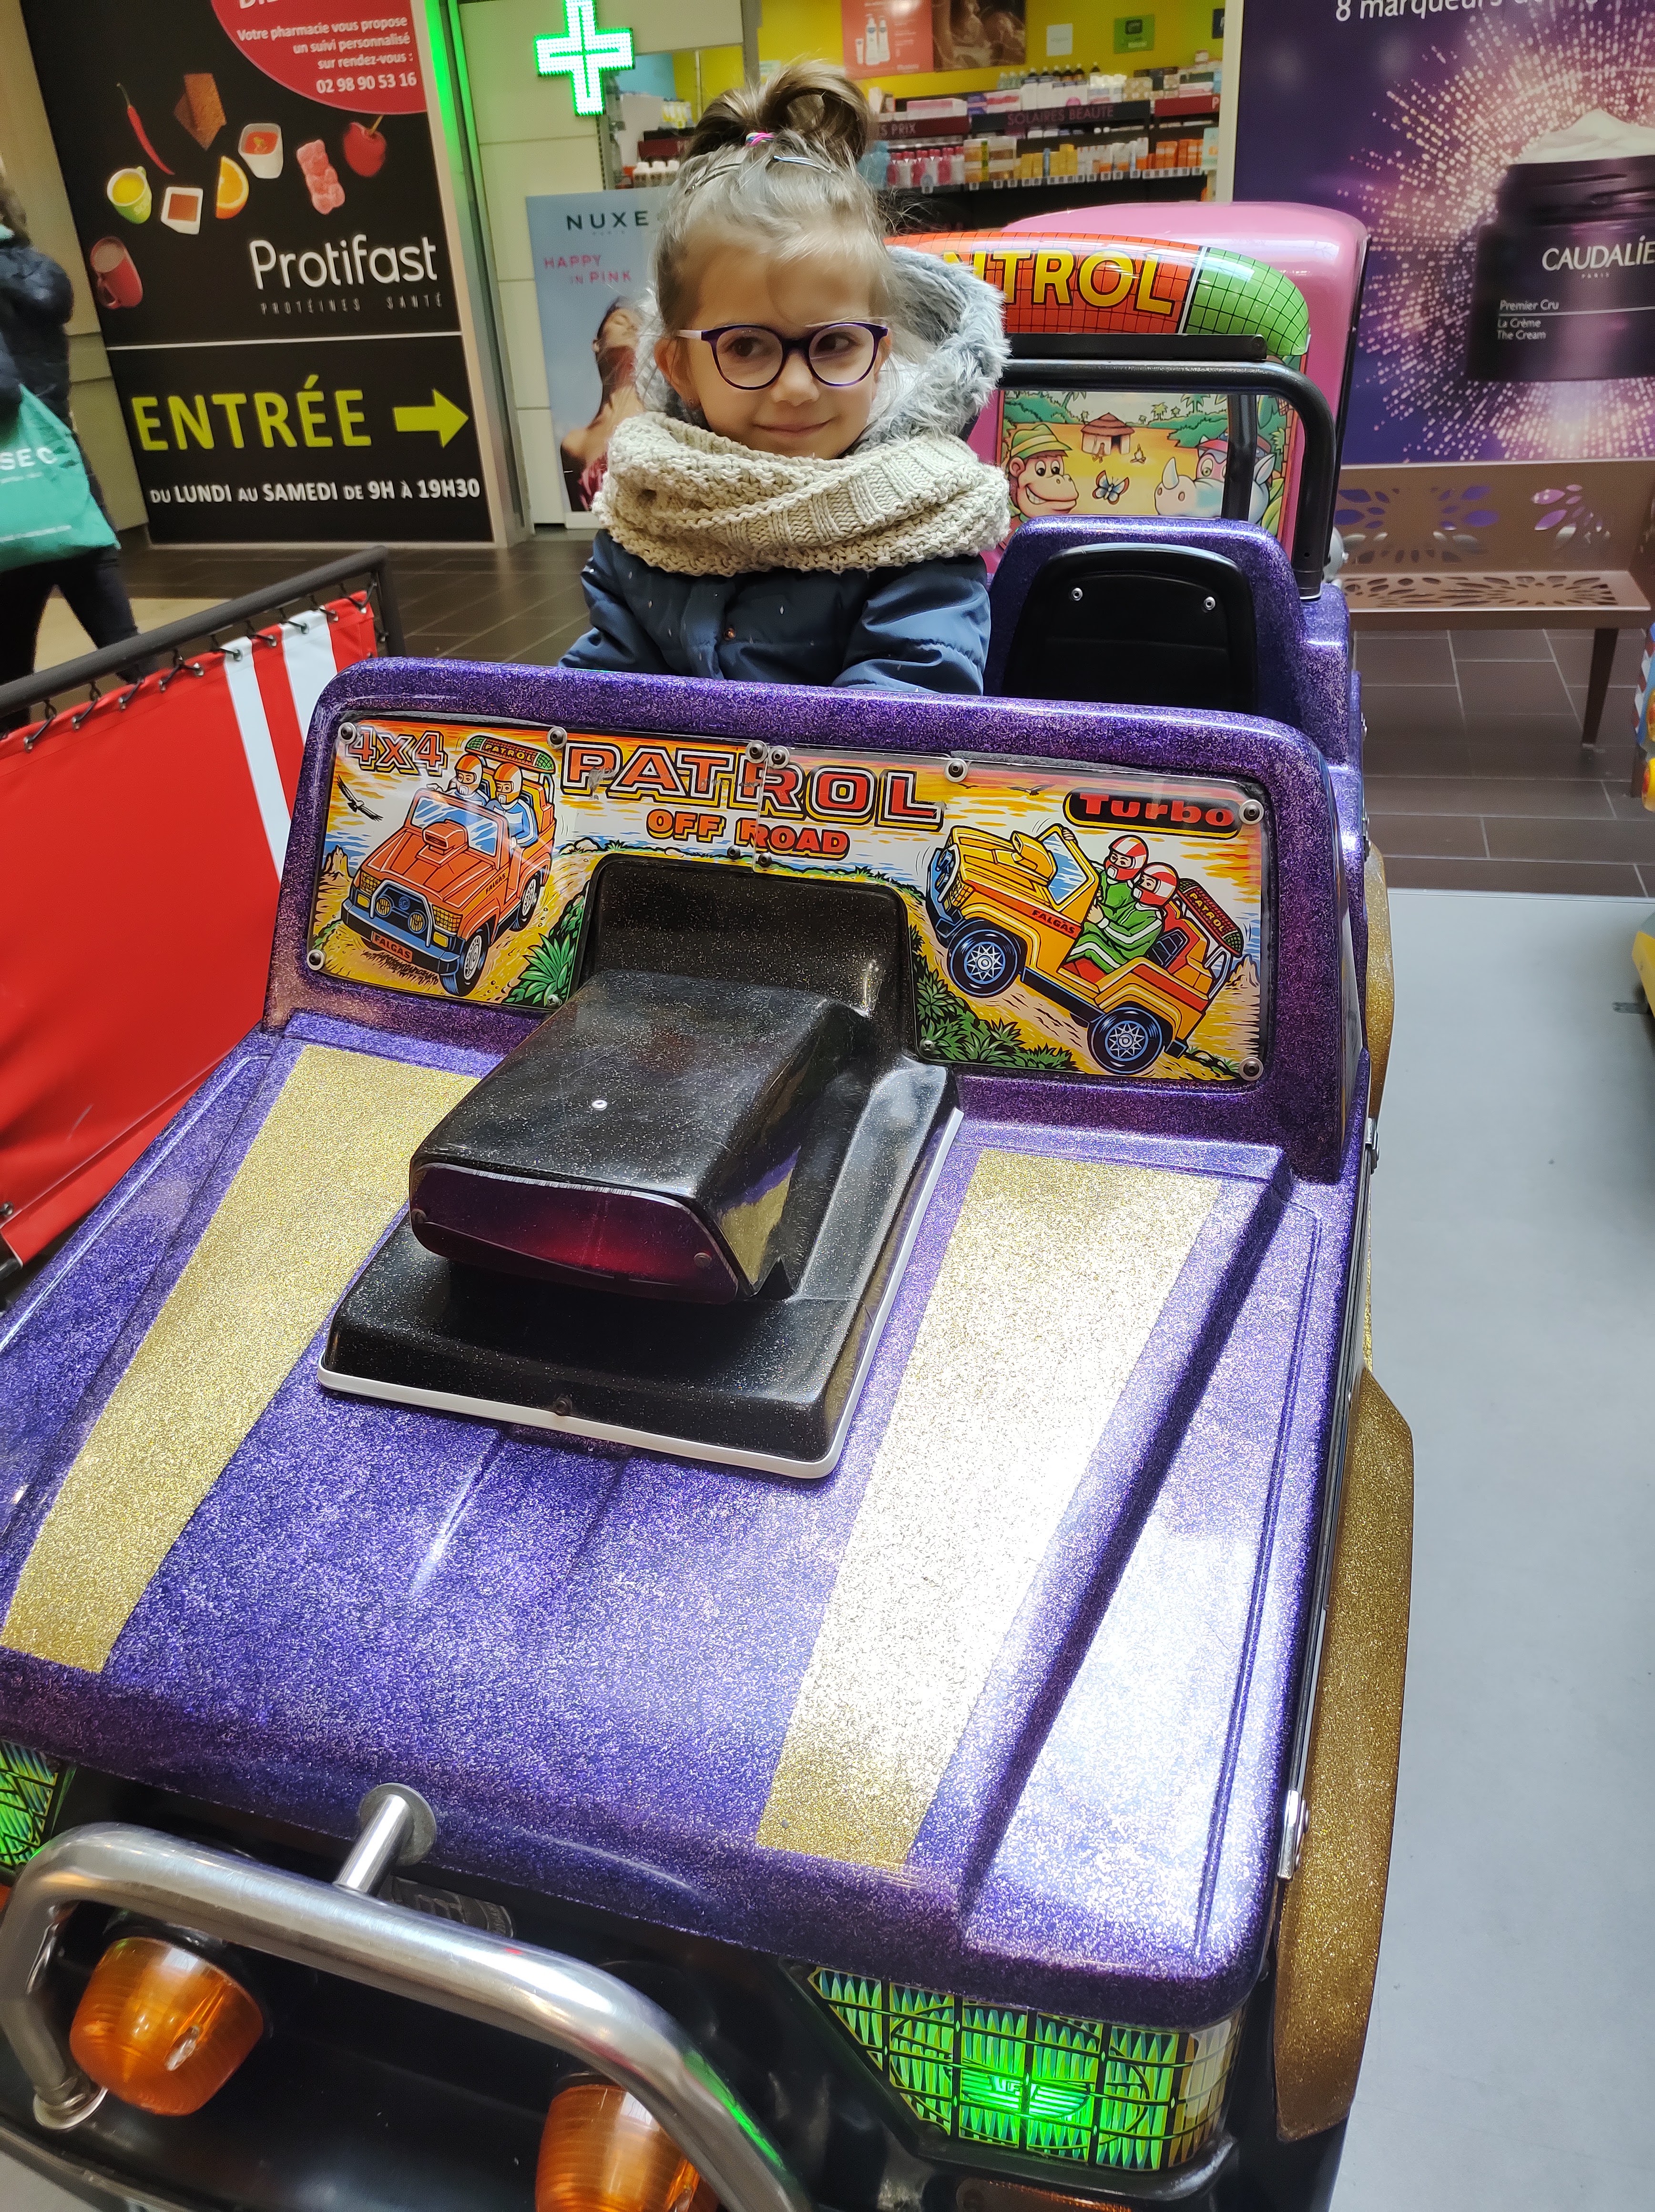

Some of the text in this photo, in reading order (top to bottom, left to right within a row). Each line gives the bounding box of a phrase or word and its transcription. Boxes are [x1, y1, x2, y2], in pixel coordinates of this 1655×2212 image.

[237, 17, 408, 41] Votre pharmacie vous propose
[293, 32, 410, 54] un suivi personnalisé
[318, 59, 335, 69] sur
[338, 53, 407, 68] rendez-vous
[316, 72, 417, 93] 02 98 90 53 16
[1007, 108, 1065, 125] SOLAIRES
[891, 122, 916, 136] PRIX
[567, 210, 649, 230] NUXE
[249, 234, 438, 290] Protifast
[544, 254, 601, 269] HAPPY
[590, 269, 632, 283] PINK
[261, 292, 443, 315] PROTÉINES SANTÉ
[1500, 299, 1559, 310] Premier Cru
[1498, 318, 1542, 328] La Crème
[1497, 330, 1547, 340] The Cream
[131, 374, 372, 451] ENTRÉE
[149, 478, 480, 503] DU LUNDI AU SAMEDI DE 9H À 19H30
[485, 744, 532, 761] PATROL
[562, 743, 945, 831] PATROL
[1079, 792, 1234, 826] Turbo
[646, 809, 851, 860] OFF ROAD
[1189, 892, 1225, 932] PATROL
